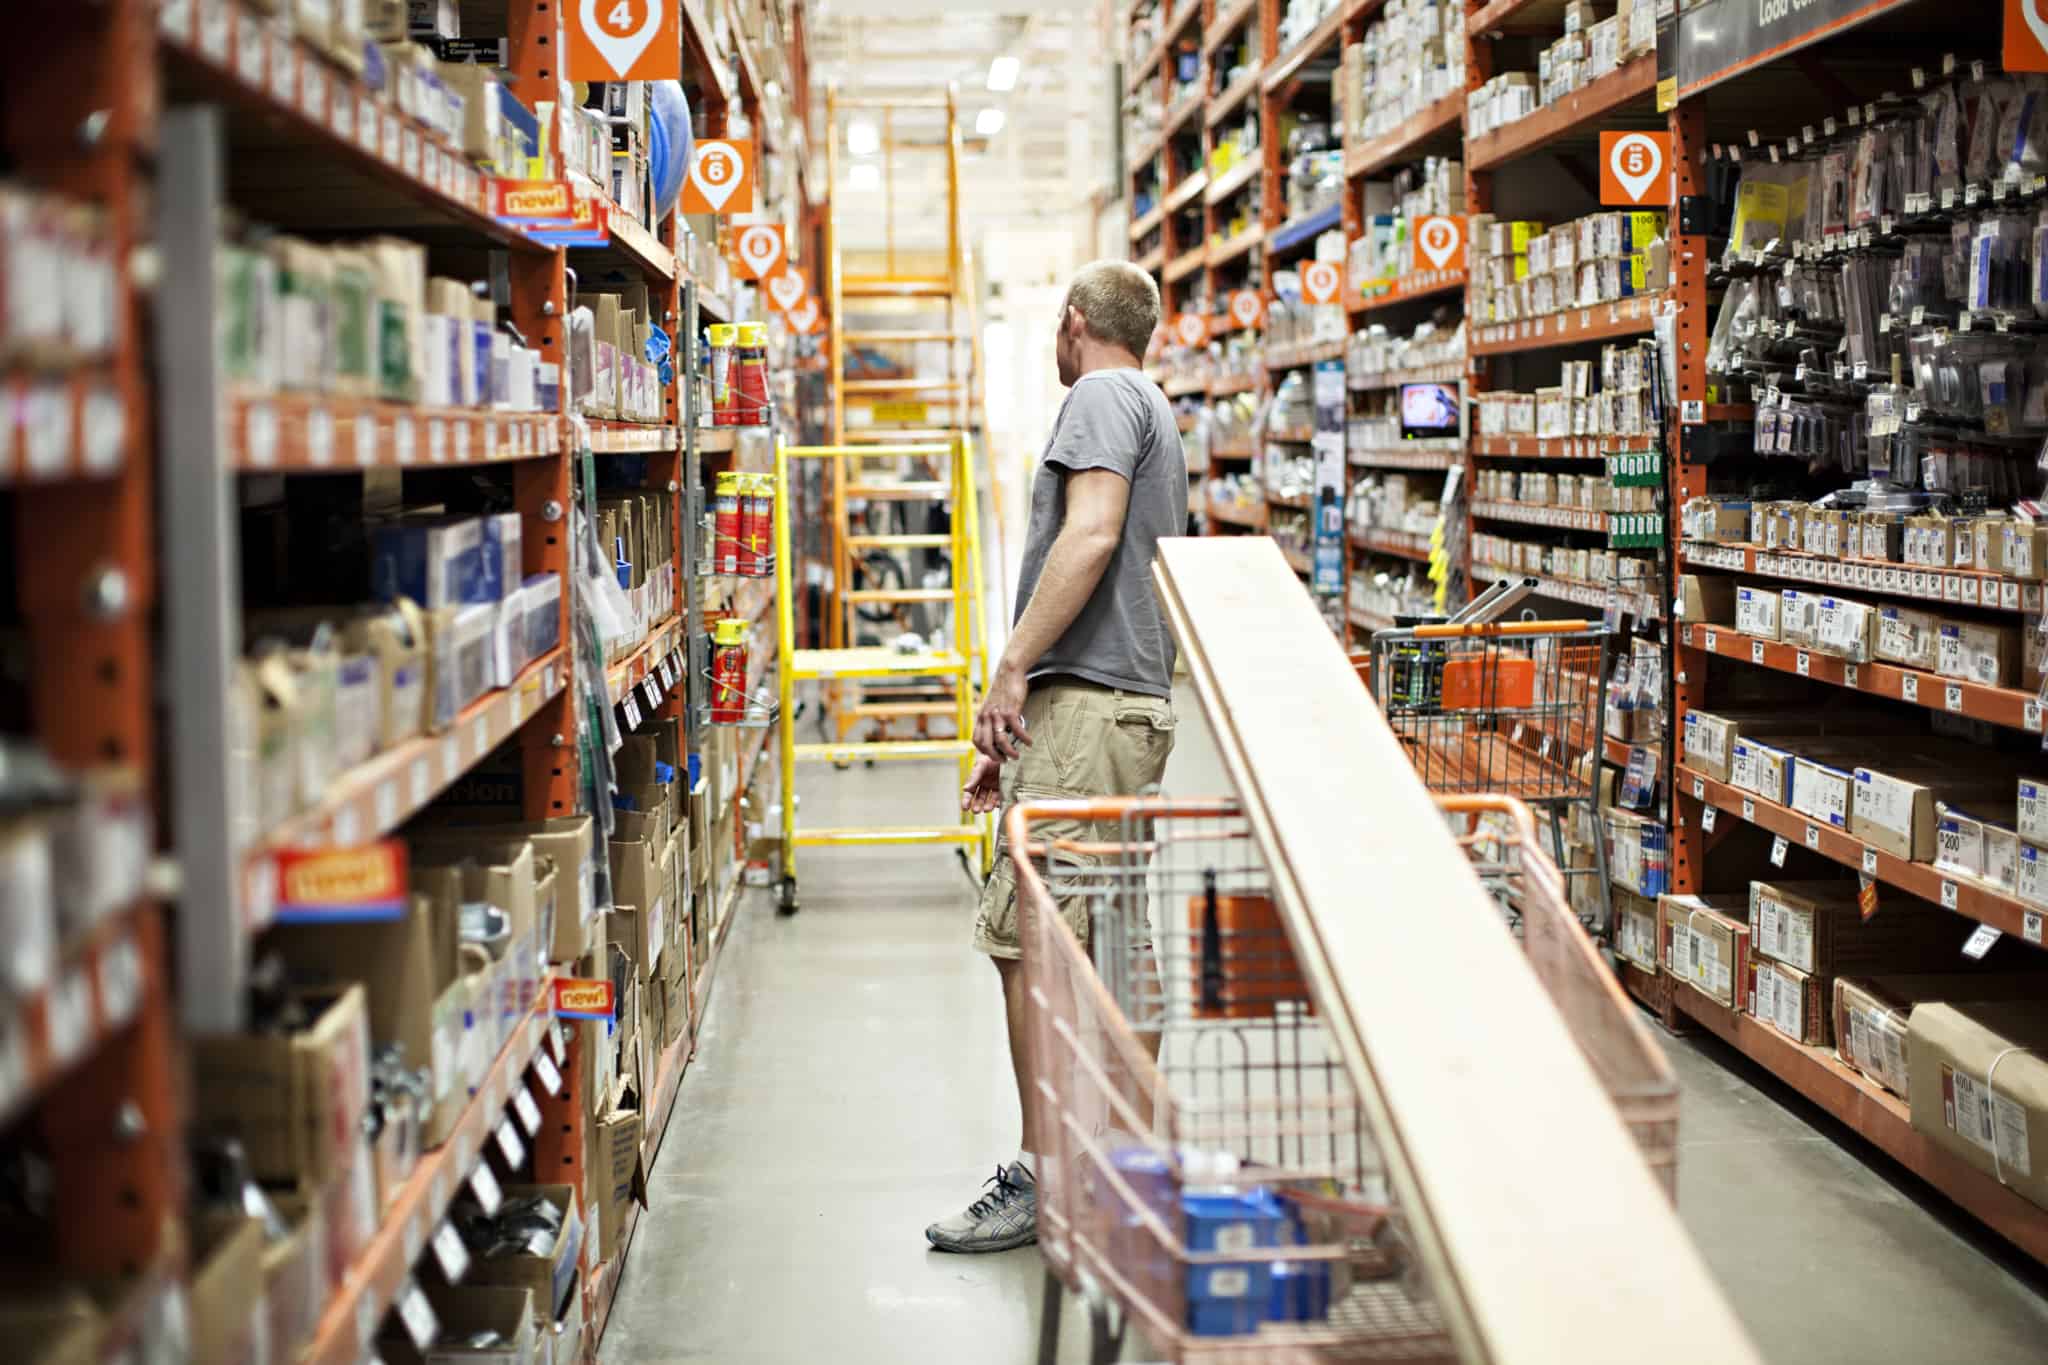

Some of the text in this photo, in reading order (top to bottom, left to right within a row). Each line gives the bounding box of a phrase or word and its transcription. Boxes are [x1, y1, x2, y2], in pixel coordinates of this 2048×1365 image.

[608, 0, 632, 30] 4
[708, 161, 724, 180] 6
[1628, 152, 1643, 173] 5
[507, 187, 564, 209] new!
[1635, 215, 1652, 224] 100
[1944, 833, 1960, 851] 200
[563, 988, 605, 1005] new!
